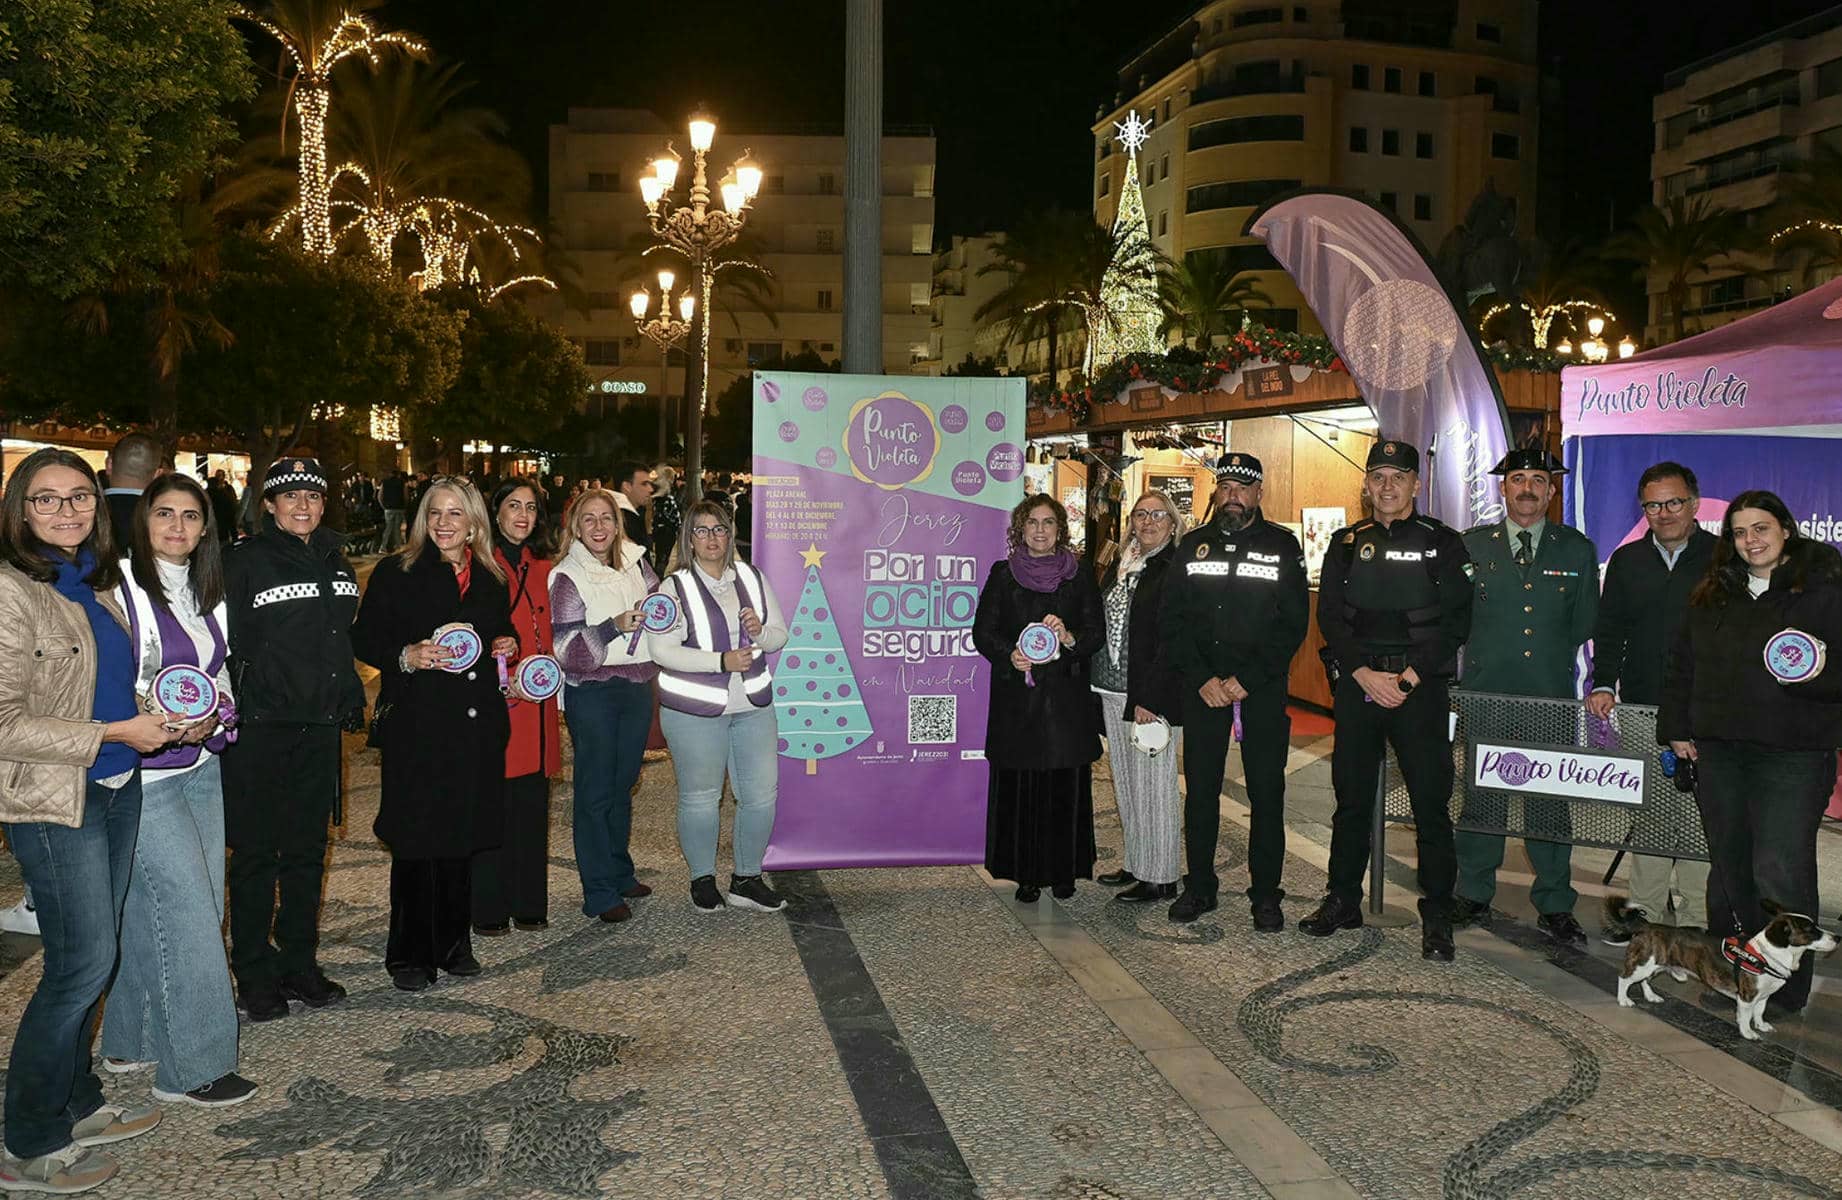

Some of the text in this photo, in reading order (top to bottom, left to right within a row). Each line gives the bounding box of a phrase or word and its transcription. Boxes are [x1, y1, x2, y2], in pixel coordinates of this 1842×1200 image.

[601, 380, 646, 394] OCASO
[1578, 366, 1748, 422] Punto Violeta
[863, 406, 921, 445] Punto
[862, 444, 921, 471] Violeta
[877, 494, 968, 548] Jerez
[1797, 513, 1842, 542] siste
[864, 549, 976, 581] Por un
[864, 582, 977, 627] ocio
[862, 664, 978, 696] en Navidad
[1480, 751, 1641, 792] Punto Violeta
